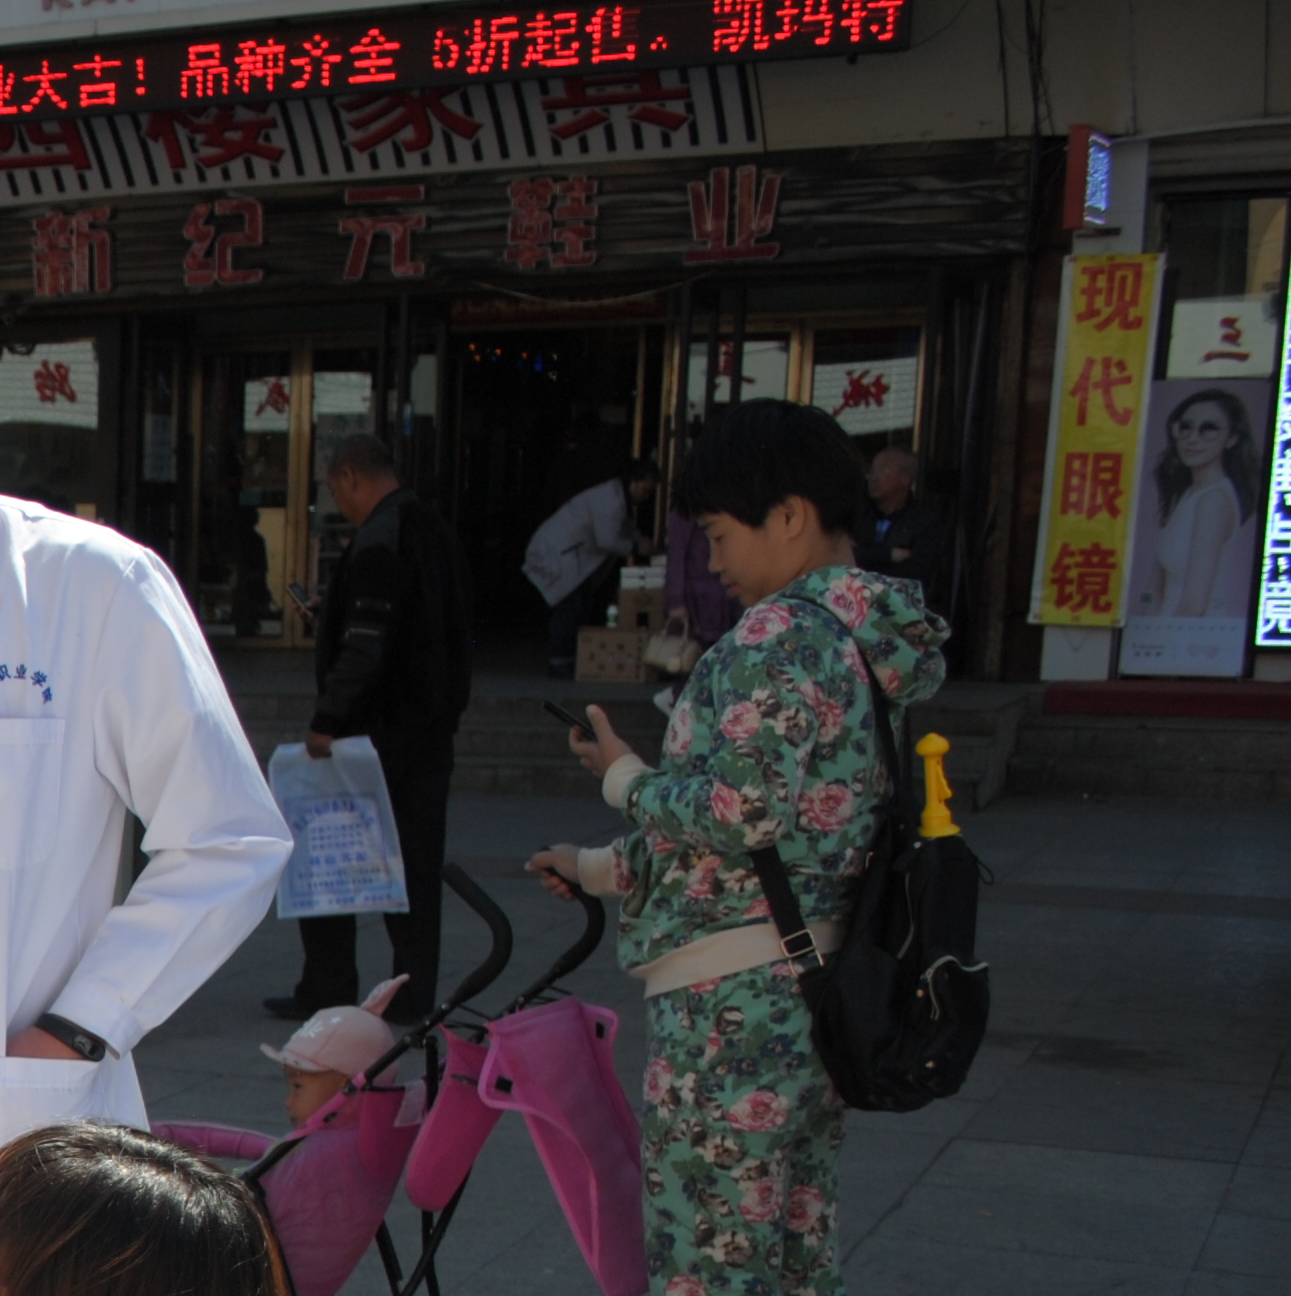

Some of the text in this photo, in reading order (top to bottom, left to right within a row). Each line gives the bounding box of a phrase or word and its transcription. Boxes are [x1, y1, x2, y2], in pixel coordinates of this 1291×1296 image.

[180, 28, 401, 99] 品种齐全
[31, 164, 783, 298] 新纪元鞋业
[1049, 259, 1144, 617] 现代眼镜
